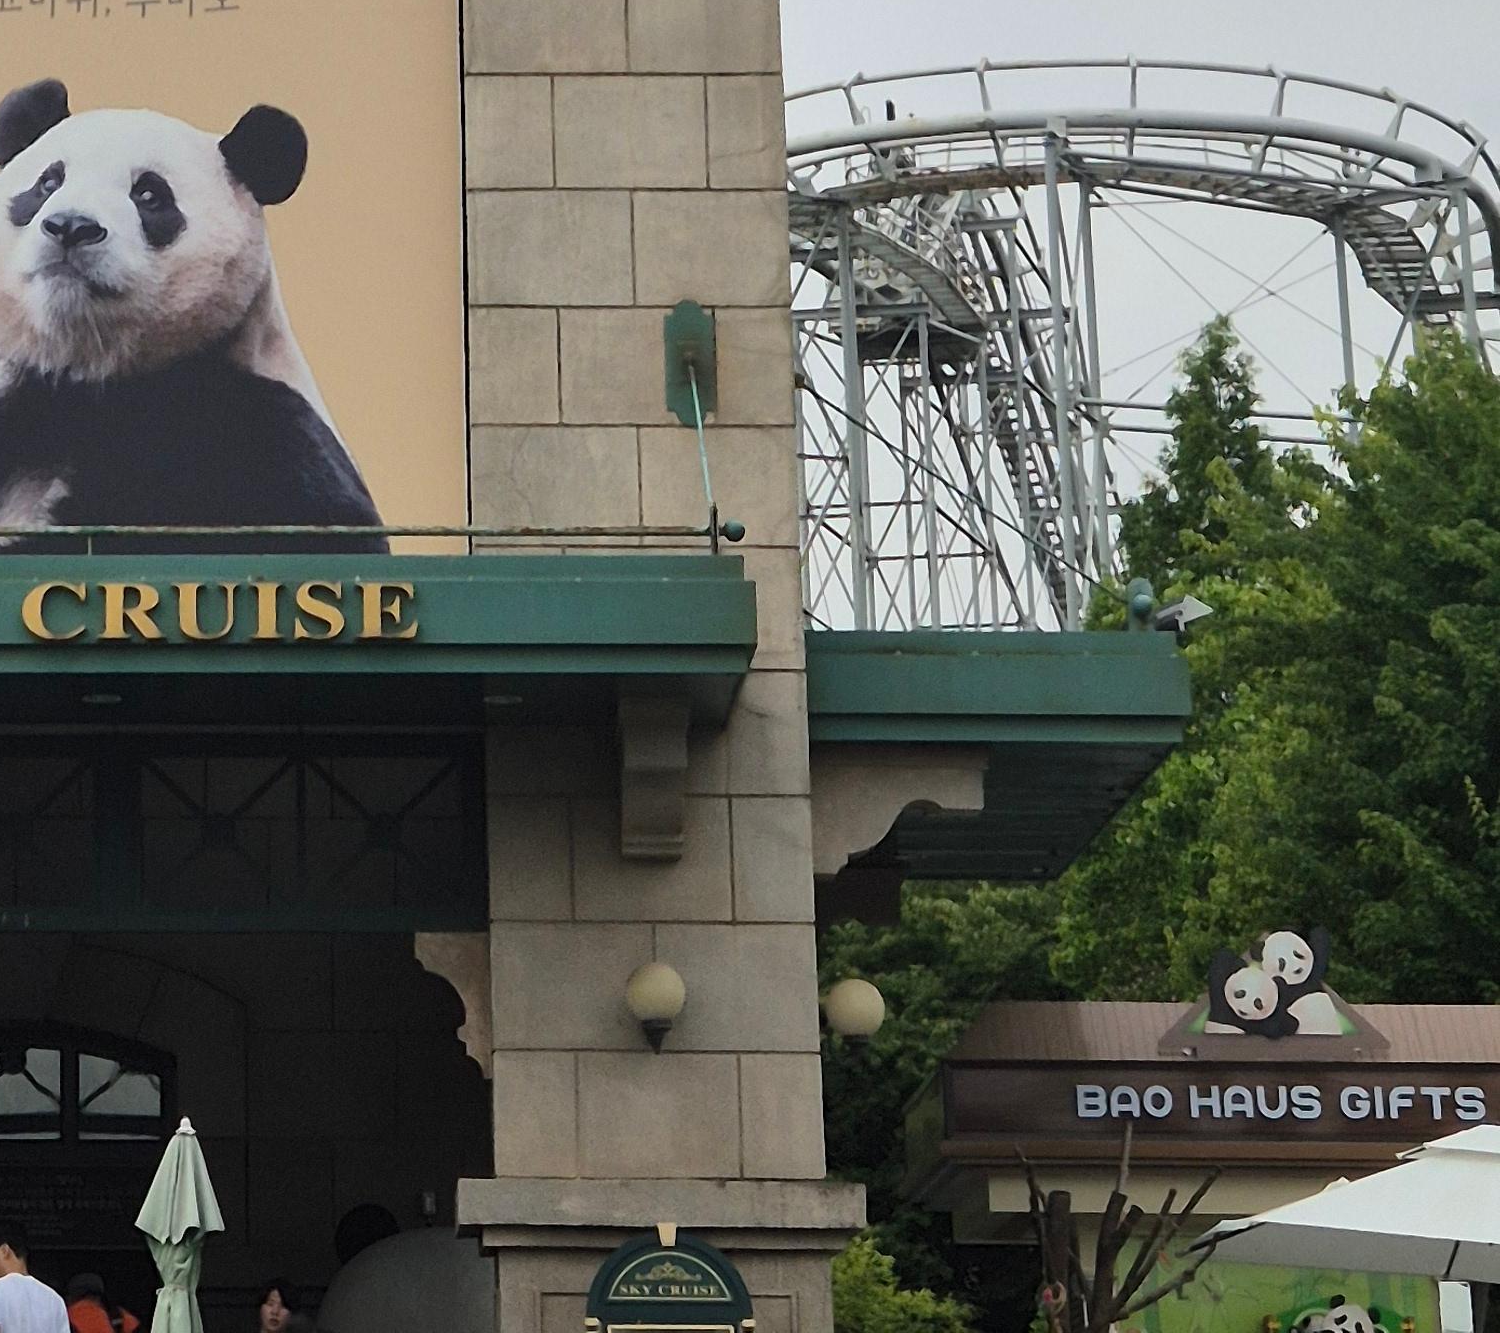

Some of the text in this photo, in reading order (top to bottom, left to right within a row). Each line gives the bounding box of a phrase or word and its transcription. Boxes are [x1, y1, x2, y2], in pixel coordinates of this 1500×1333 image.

[21, 580, 419, 641] CRUISE
[1075, 1084, 1487, 1122] BAO HAUS GIFTS
[619, 1284, 721, 1296] SKY CRUISE
